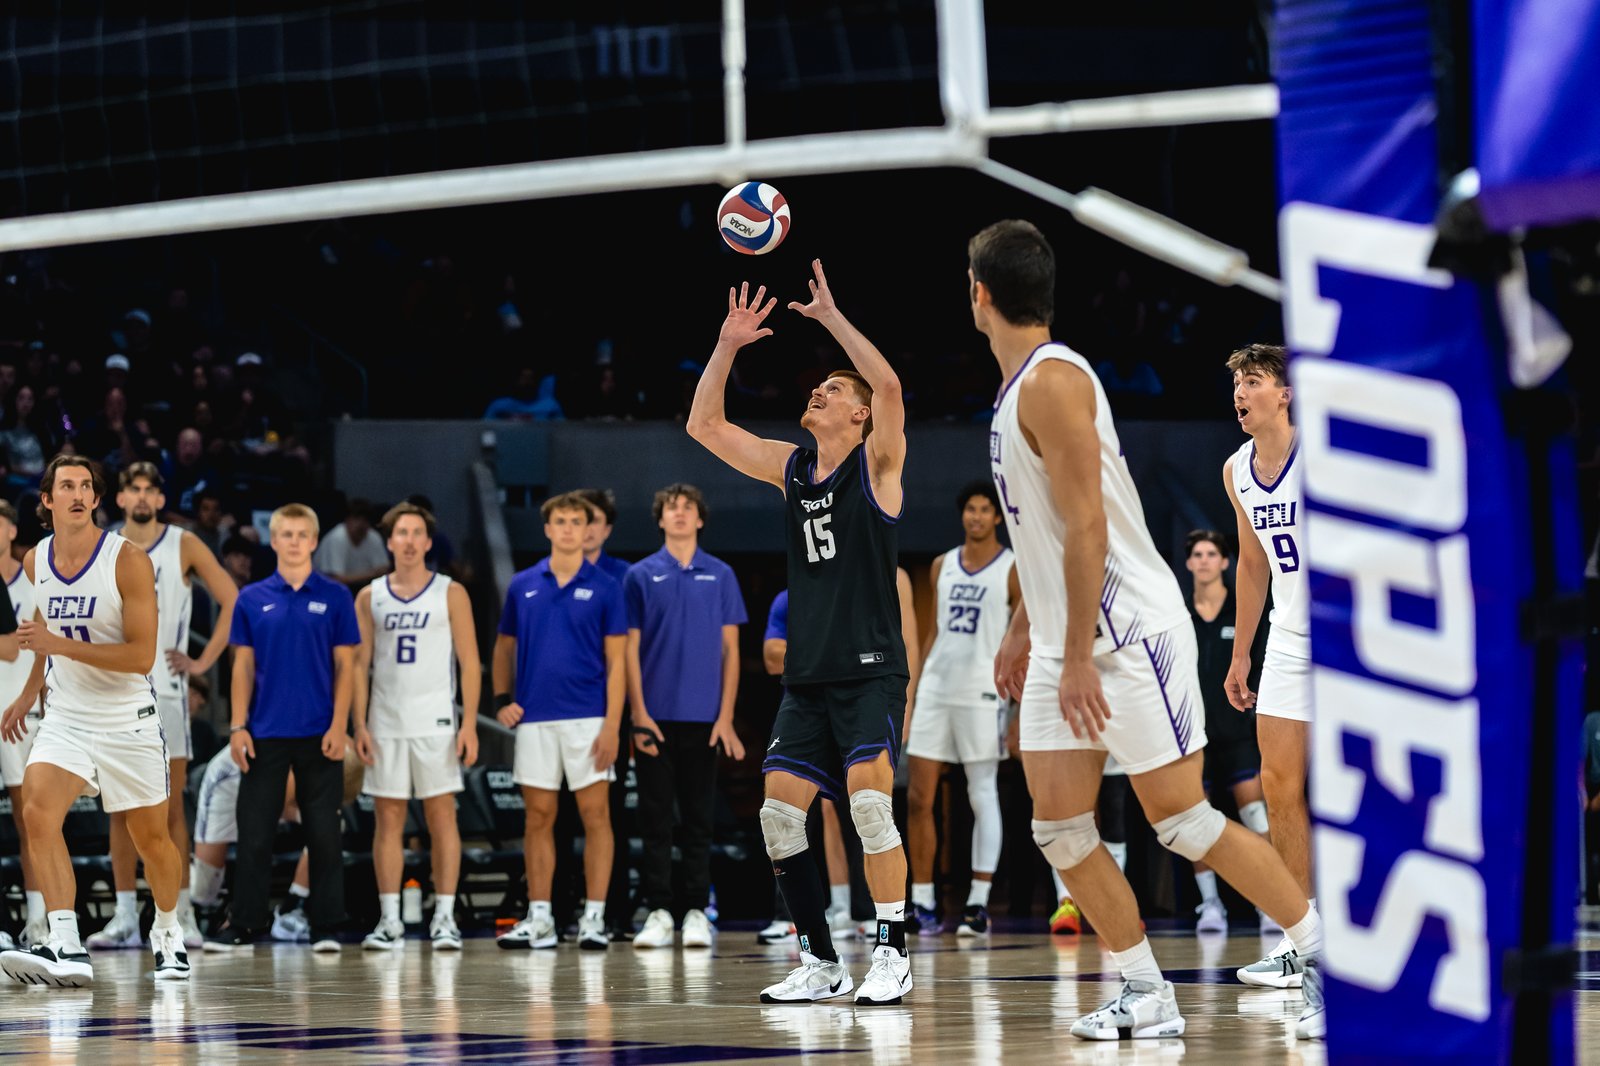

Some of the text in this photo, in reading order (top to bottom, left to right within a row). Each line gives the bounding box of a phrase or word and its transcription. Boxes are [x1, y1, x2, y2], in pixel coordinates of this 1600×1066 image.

[729, 217, 755, 236] NCAA
[1253, 501, 1297, 530] GCU
[803, 513, 837, 563] 15
[1272, 533, 1300, 574] 9
[47, 596, 97, 619] GCU
[949, 584, 987, 602] GCU
[384, 611, 430, 631] GCU
[948, 605, 981, 634] 23
[1279, 201, 1490, 1022] LOPES
[396, 634, 416, 664] 6
